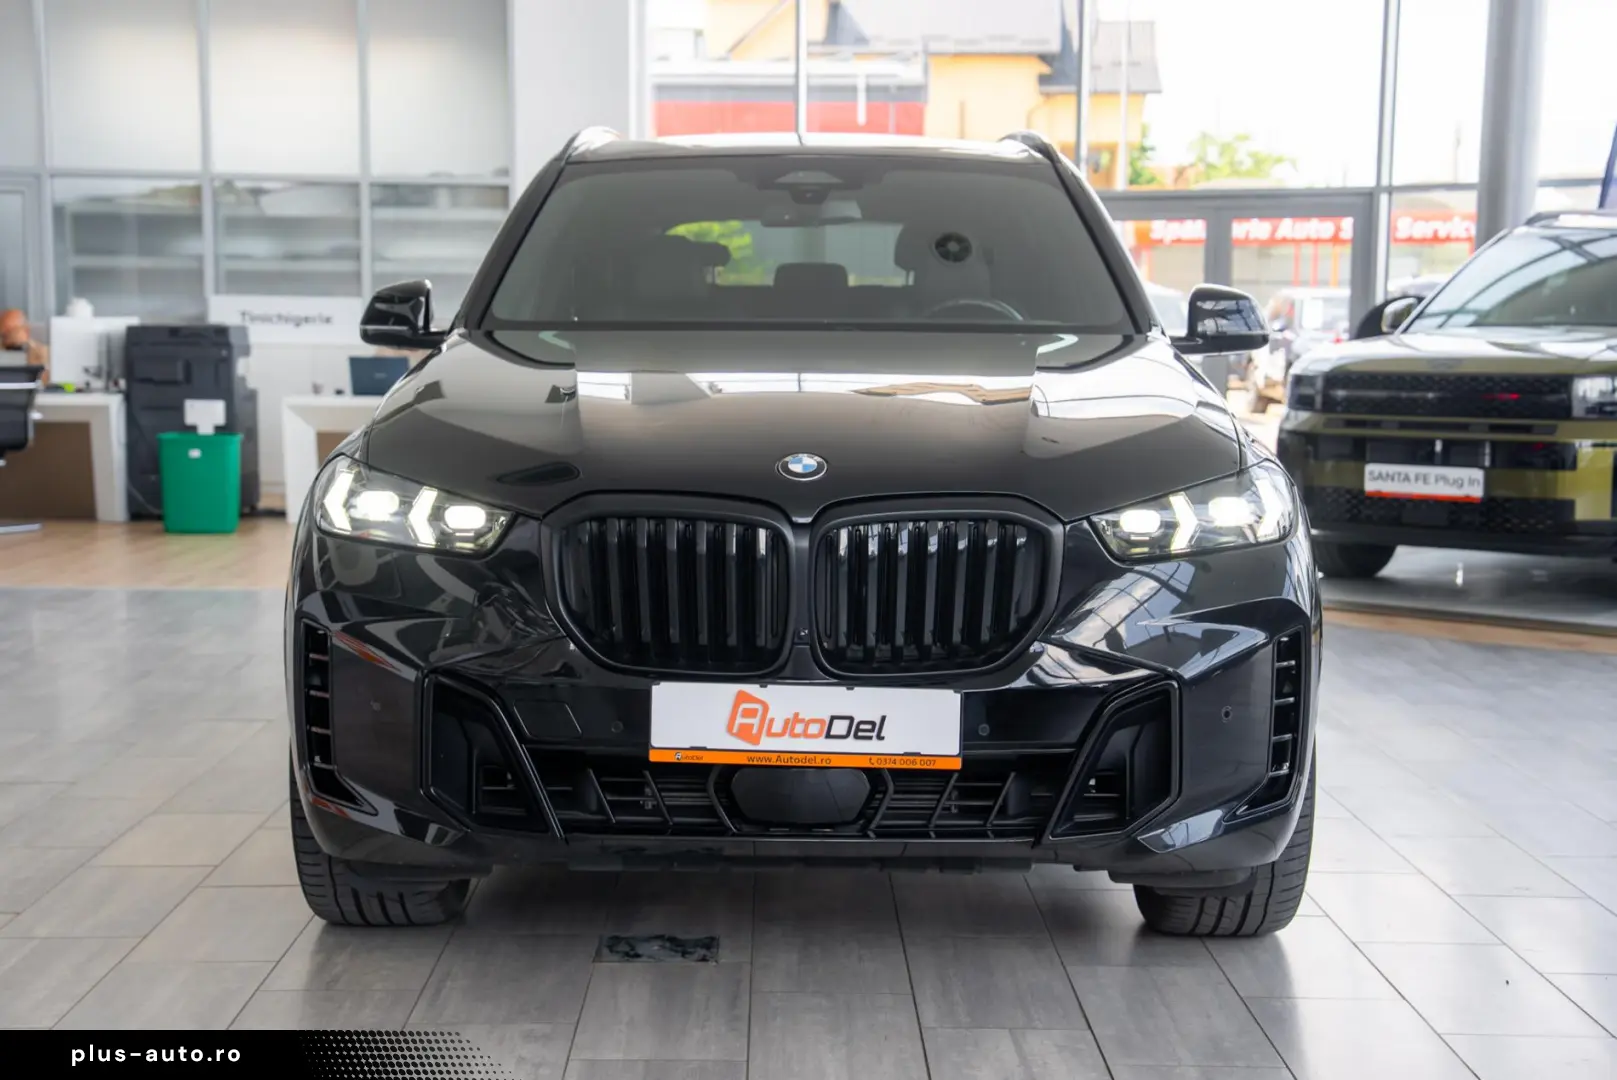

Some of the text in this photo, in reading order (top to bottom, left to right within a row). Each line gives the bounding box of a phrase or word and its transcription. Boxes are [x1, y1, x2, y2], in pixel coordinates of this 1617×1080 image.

[1274, 217, 1335, 240] Auto
[1395, 216, 1476, 240] Servic
[1368, 469, 1480, 490] SANTA FE Plug In
[726, 690, 887, 745] AutoDel
[746, 754, 832, 766] www.Autodel.ro
[876, 758, 937, 767] 0374 006 007
